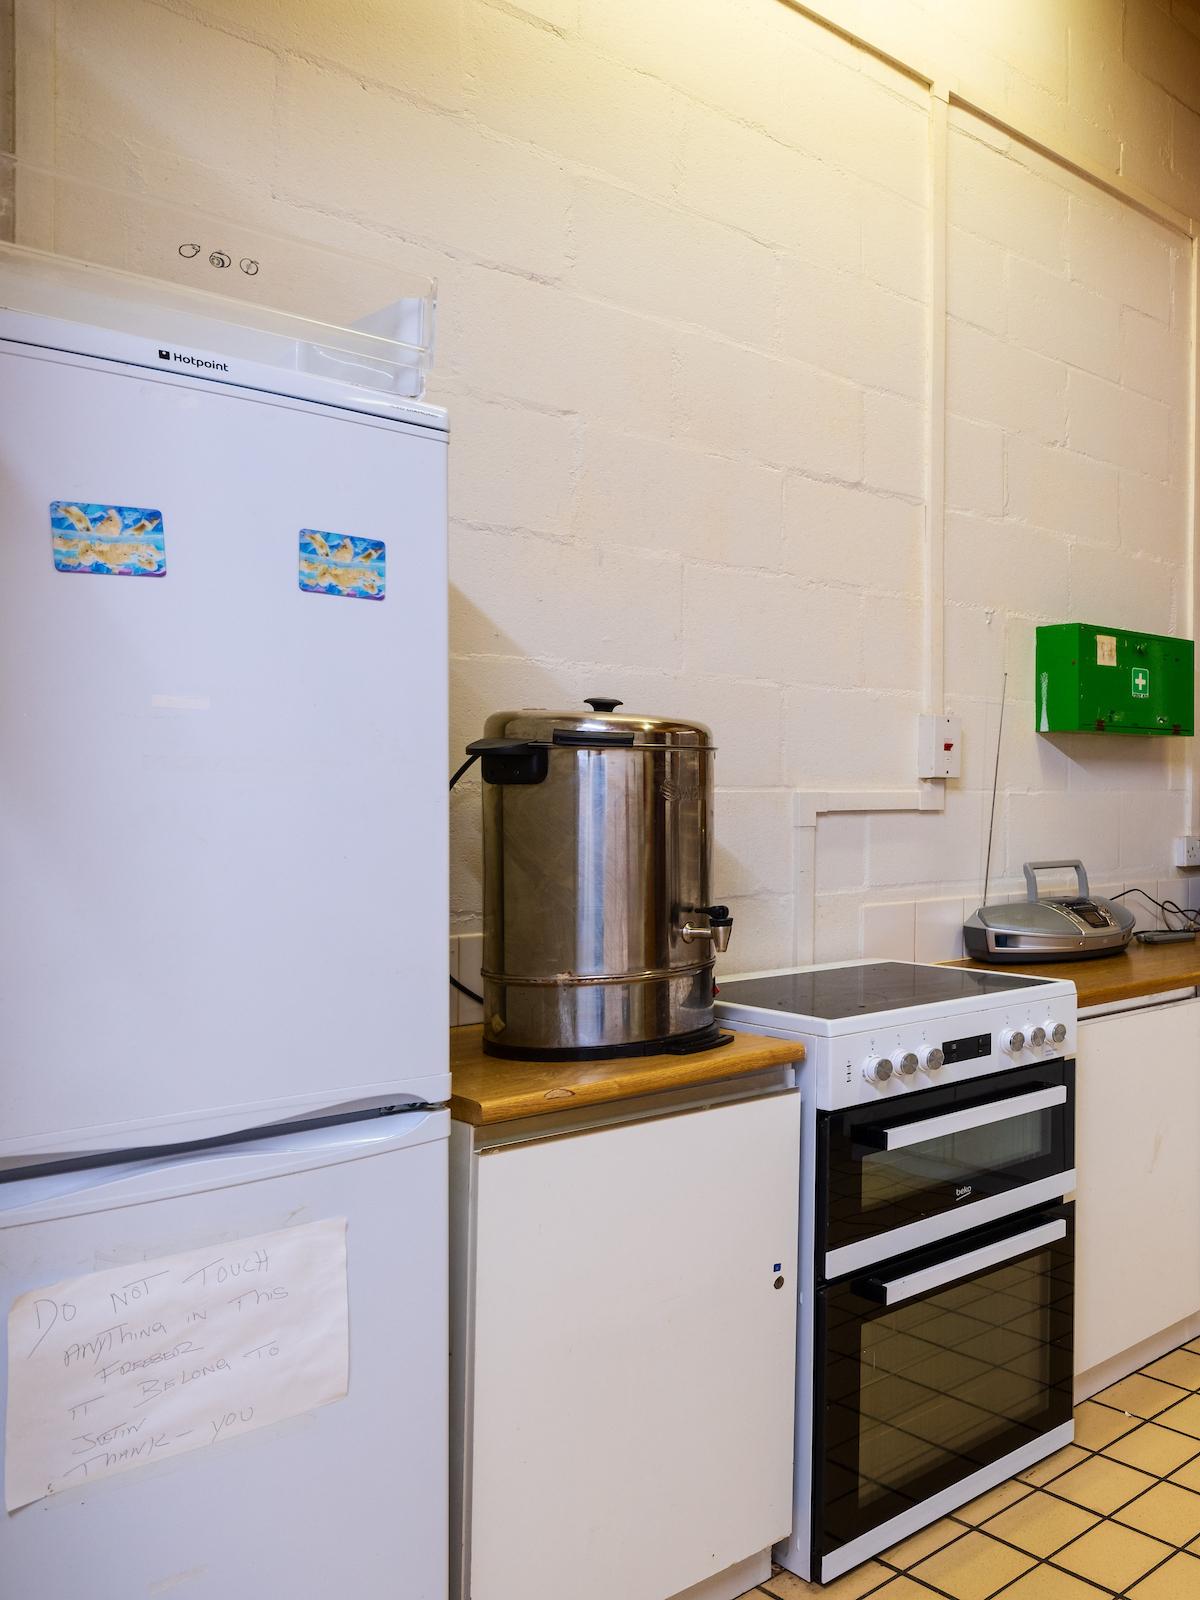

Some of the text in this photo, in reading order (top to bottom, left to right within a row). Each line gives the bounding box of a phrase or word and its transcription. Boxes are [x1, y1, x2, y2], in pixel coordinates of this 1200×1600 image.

[173, 352, 229, 372] Hotpoint
[955, 1185, 972, 1198] beko
[27, 1248, 269, 1360] DO NOT TOUCH
[67, 1340, 280, 1421] IT BELONG TO
